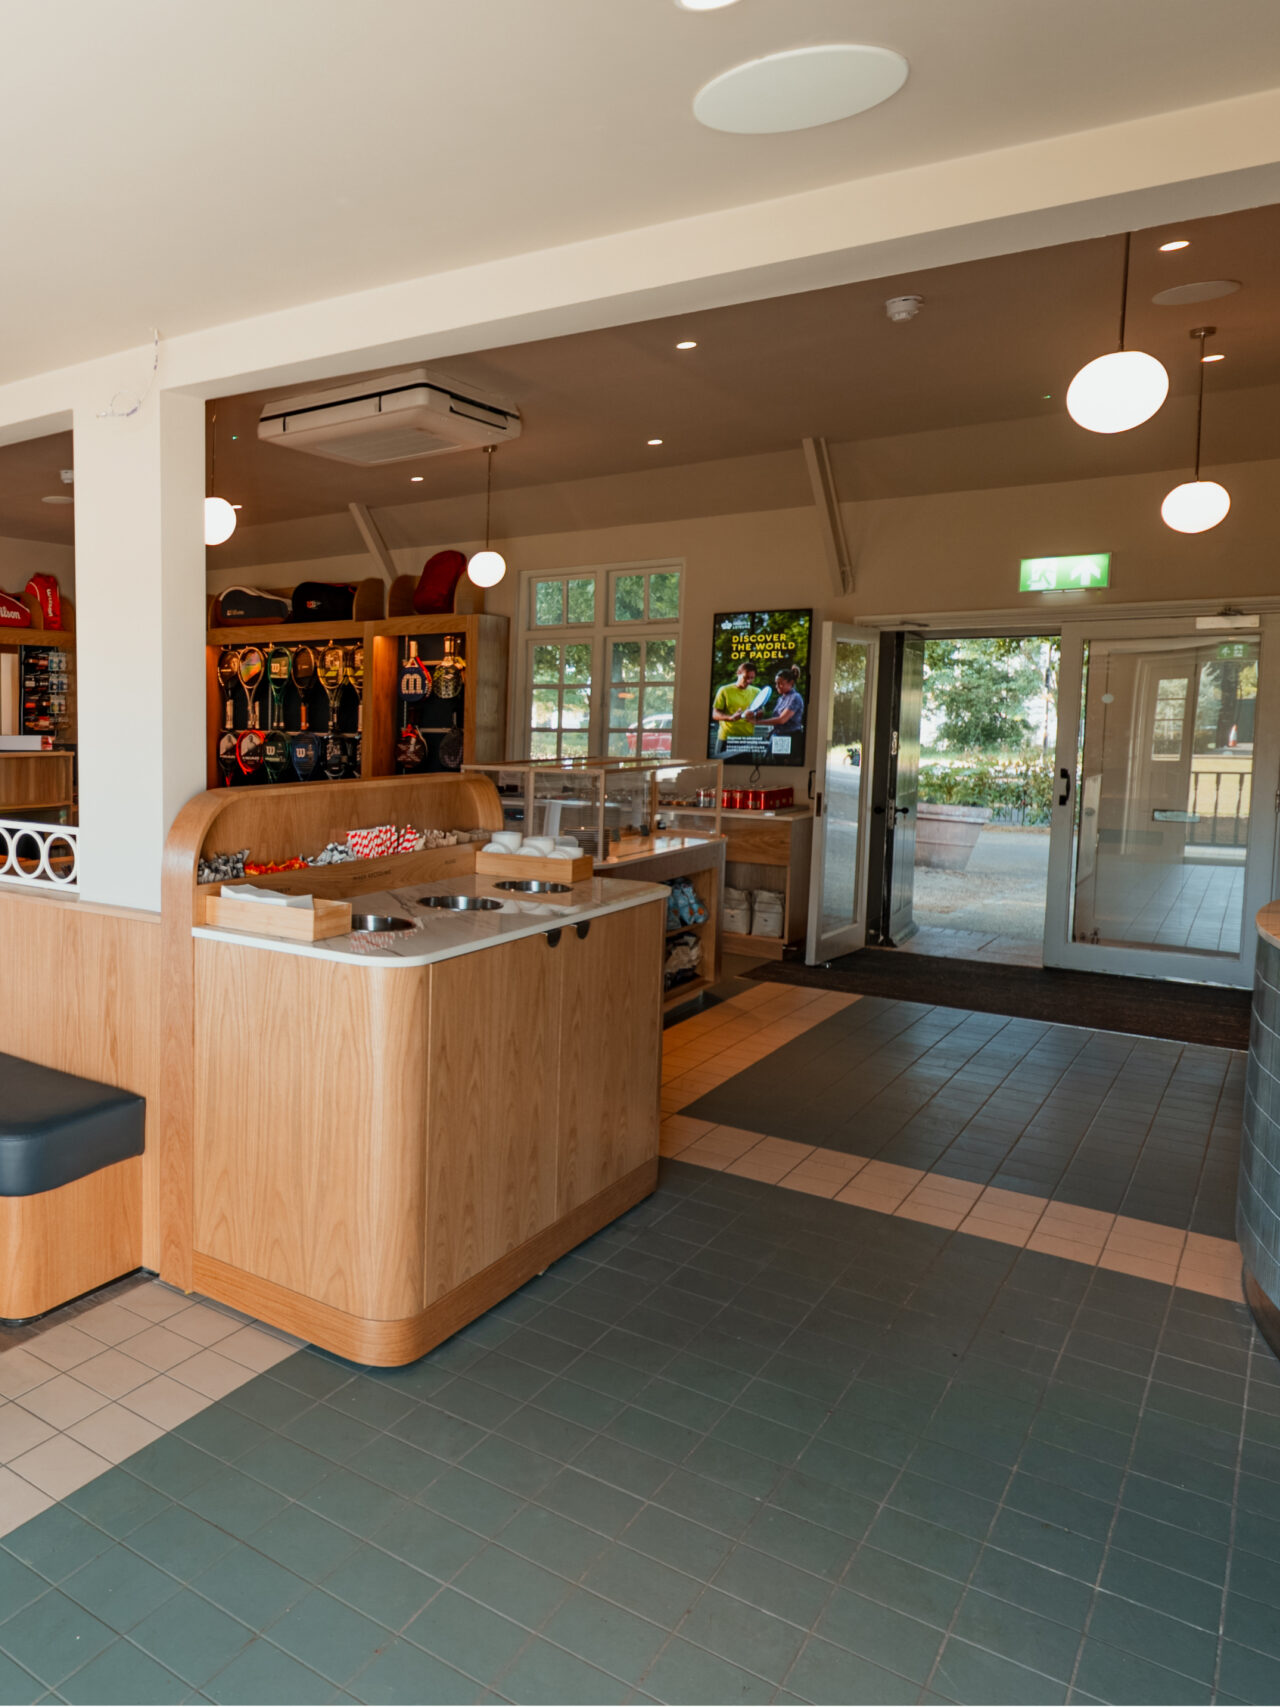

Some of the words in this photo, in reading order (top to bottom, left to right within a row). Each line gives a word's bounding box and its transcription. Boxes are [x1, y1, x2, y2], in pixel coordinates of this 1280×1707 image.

[732, 634, 786, 643] DISCOVER
[731, 643, 752, 651] THE
[755, 641, 796, 650] WORLD
[730, 651, 746, 660] OF
[749, 650, 784, 659] PADEL
